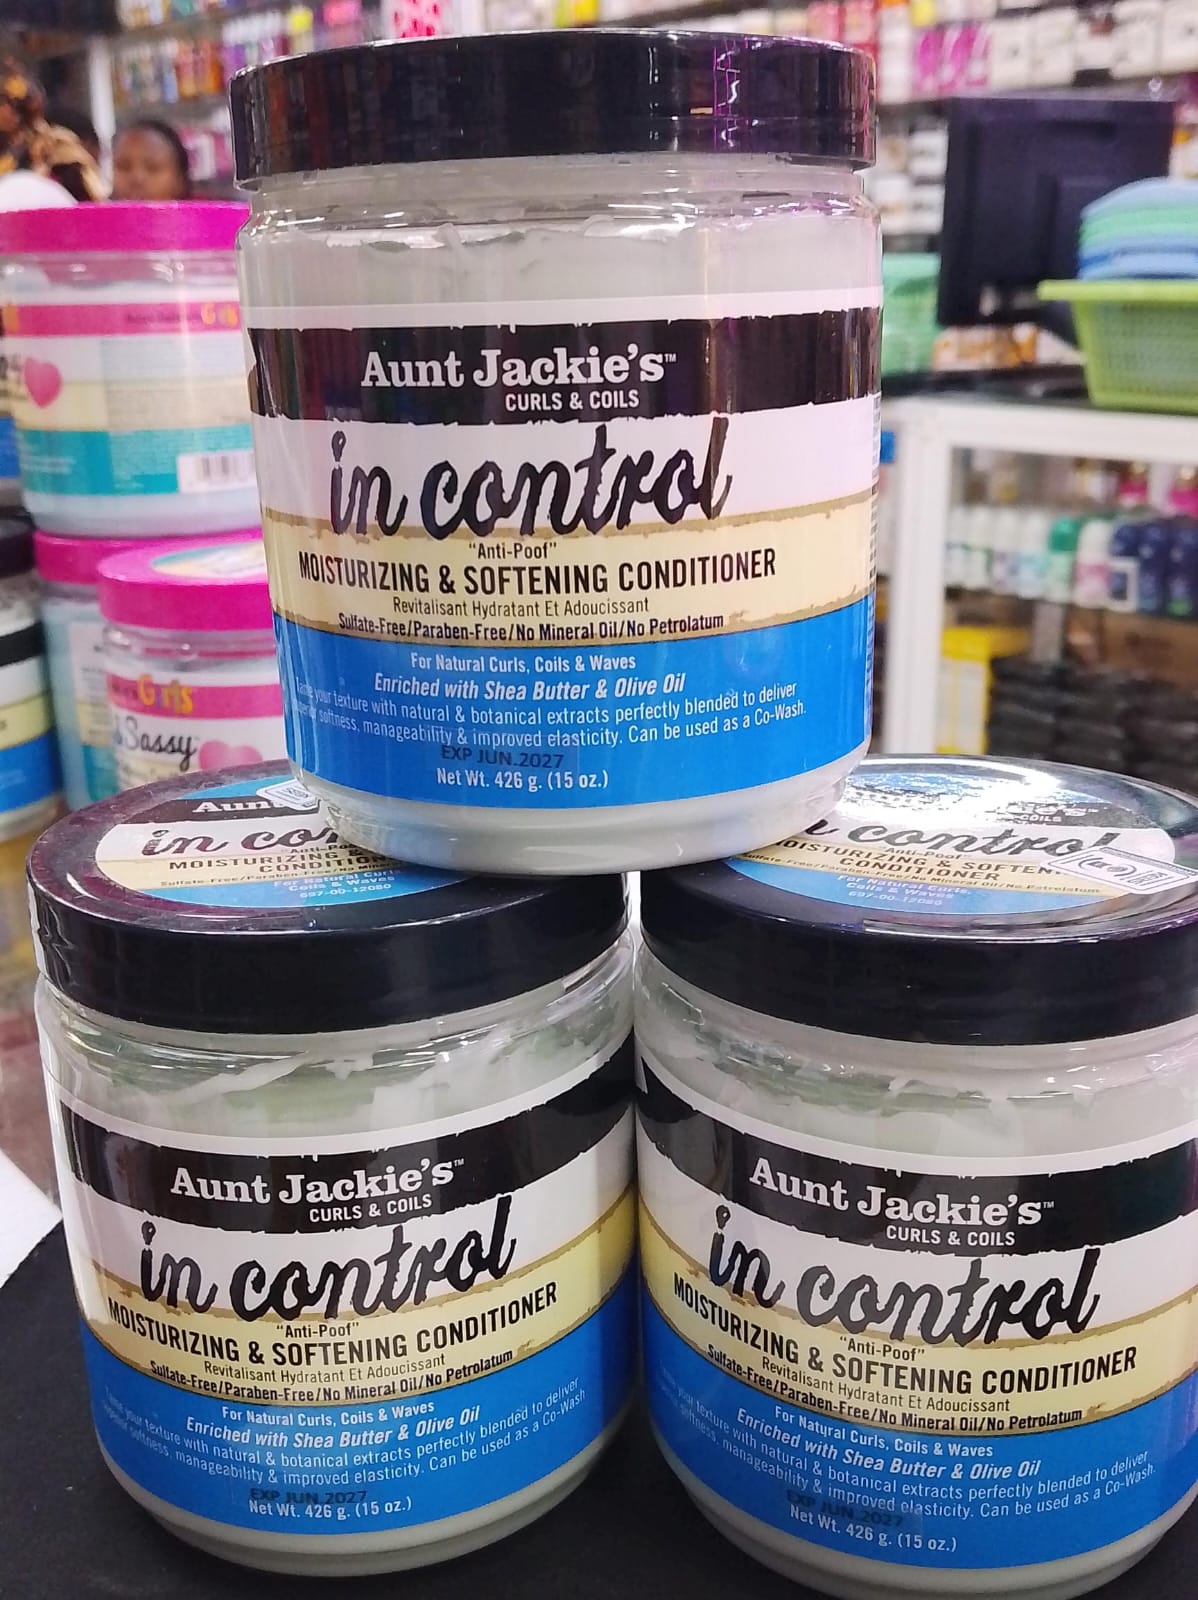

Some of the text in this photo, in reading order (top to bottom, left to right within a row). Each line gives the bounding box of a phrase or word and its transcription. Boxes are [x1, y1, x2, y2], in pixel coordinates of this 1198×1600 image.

[361, 350, 464, 388] Aunt
[505, 389, 639, 411] CURLS & COILS
[329, 417, 732, 541] in control
[298, 548, 776, 595] MOISTURIZING & SOFTENING CONDITIONER
[393, 597, 649, 620] Revitalisant Hydratant Et Adoucissant
[539, 621, 595, 641] Mineral
[600, 620, 645, 639] Oil/No
[650, 615, 724, 636] Petrolatum
[411, 654, 636, 675] For Natural Curls, Coils & Waves
[333, 690, 369, 712] texture
[371, 699, 397, 716] with
[401, 704, 449, 722] natural
[455, 706, 465, 723] &
[471, 706, 542, 725] botanical
[547, 706, 609, 725] extracts
[615, 701, 680, 725] perfectly
[685, 693, 739, 715] blended
[742, 690, 756, 707] to
[758, 682, 798, 703] deliver
[374, 672, 686, 701] Enriched with Shea Butter & Olive Oil
[126, 715, 198, 772] Sassy
[363, 720, 452, 744] manageability
[457, 728, 468, 745] &
[473, 729, 542, 750] improved
[547, 728, 623, 749] elasticity.
[628, 725, 658, 743] Can
[664, 722, 680, 740] be
[686, 717, 719, 737] used
[723, 716, 739, 732] as
[742, 714, 751, 728] a
[441, 744, 473, 761] EXP
[436, 768, 609, 792] Net Wt. 426 g. (15 oz.)
[142, 829, 227, 856] in
[169, 851, 339, 871] MOISTURIZING
[839, 857, 1001, 882] CONDITIONER
[170, 1167, 271, 1204] Aunt
[748, 1156, 849, 1211] Aunt
[309, 1193, 433, 1223] CURLS & COILS
[886, 1225, 1016, 1247] CURLS & COILS
[140, 1193, 517, 1323] in control
[708, 1204, 1102, 1348] in control
[107, 1281, 558, 1367] MOISTURIZING & SOFTENING CONDITIONER
[673, 1271, 1137, 1395] MOISTURIZING & SOFTENING CONDITIONER
[204, 1353, 446, 1386] Revitalisant Hydratant Et Adoucissant
[344, 1379, 396, 1400] Mineral
[400, 1371, 443, 1393] Oil/No
[446, 1350, 514, 1384] Petrolatum
[762, 1356, 1010, 1413] Revitalisant Hydratant Et Adoucissant
[186, 1404, 481, 1449] Enriched with Shea Butter & Olive Oil
[222, 1401, 436, 1428] For Natural Curls, Coils & Waves
[774, 1405, 993, 1457] For Natural Curls, Coils & Waves
[901, 1412, 955, 1431] Mineral
[960, 1416, 1005, 1432] Oil/No
[1009, 1409, 1083, 1430] Petrolatum
[353, 1431, 476, 1467] extracts perfectly
[736, 1407, 1042, 1480] Enriched with Shea Butter & Olive Oil
[249, 1496, 412, 1521] Net Wt. 426 g. (15 oz.)
[901, 1481, 1033, 1502] extracts perfectly
[790, 1503, 957, 1553] Net Wt. 426 g. (15 oz.)
